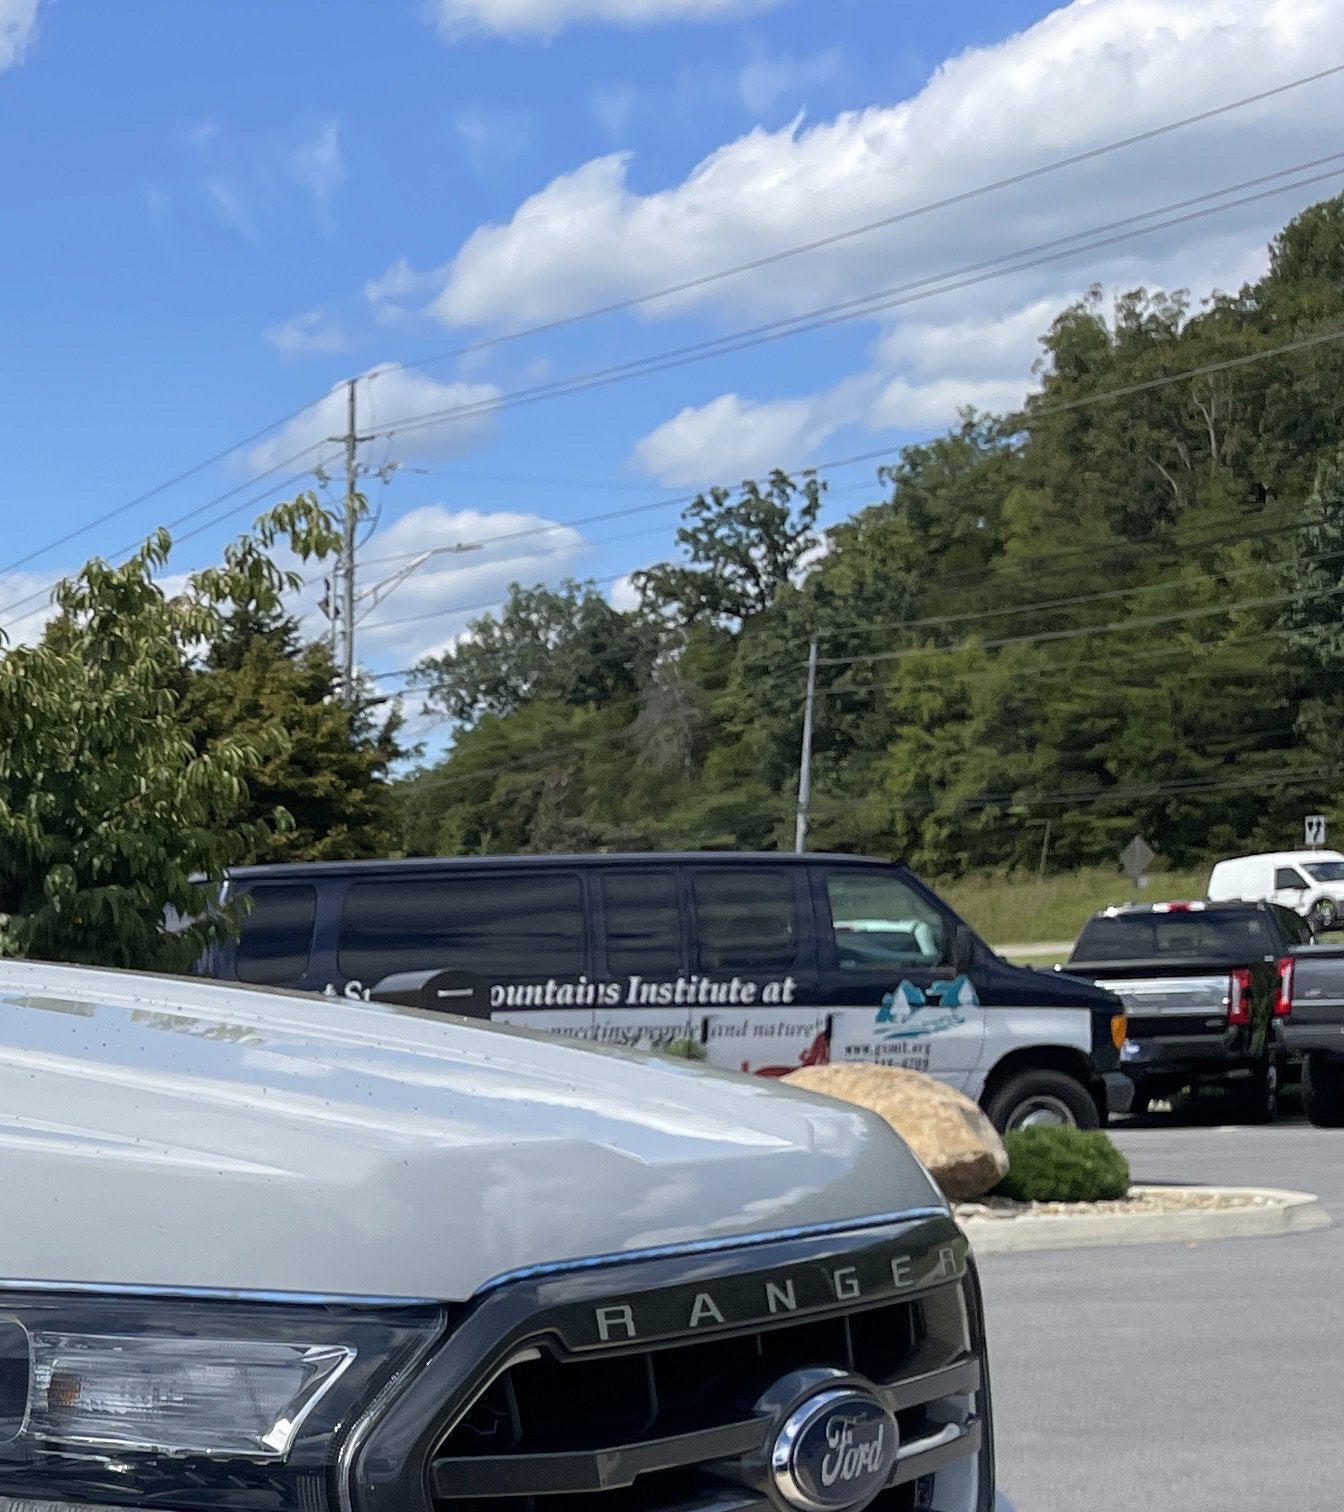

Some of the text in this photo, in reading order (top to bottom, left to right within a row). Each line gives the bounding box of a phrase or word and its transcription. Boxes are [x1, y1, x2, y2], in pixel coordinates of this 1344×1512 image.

[490, 975, 797, 1007] ountains Institute at
[595, 1247, 960, 1341] RANGER
[821, 1411, 884, 1487] Ford
